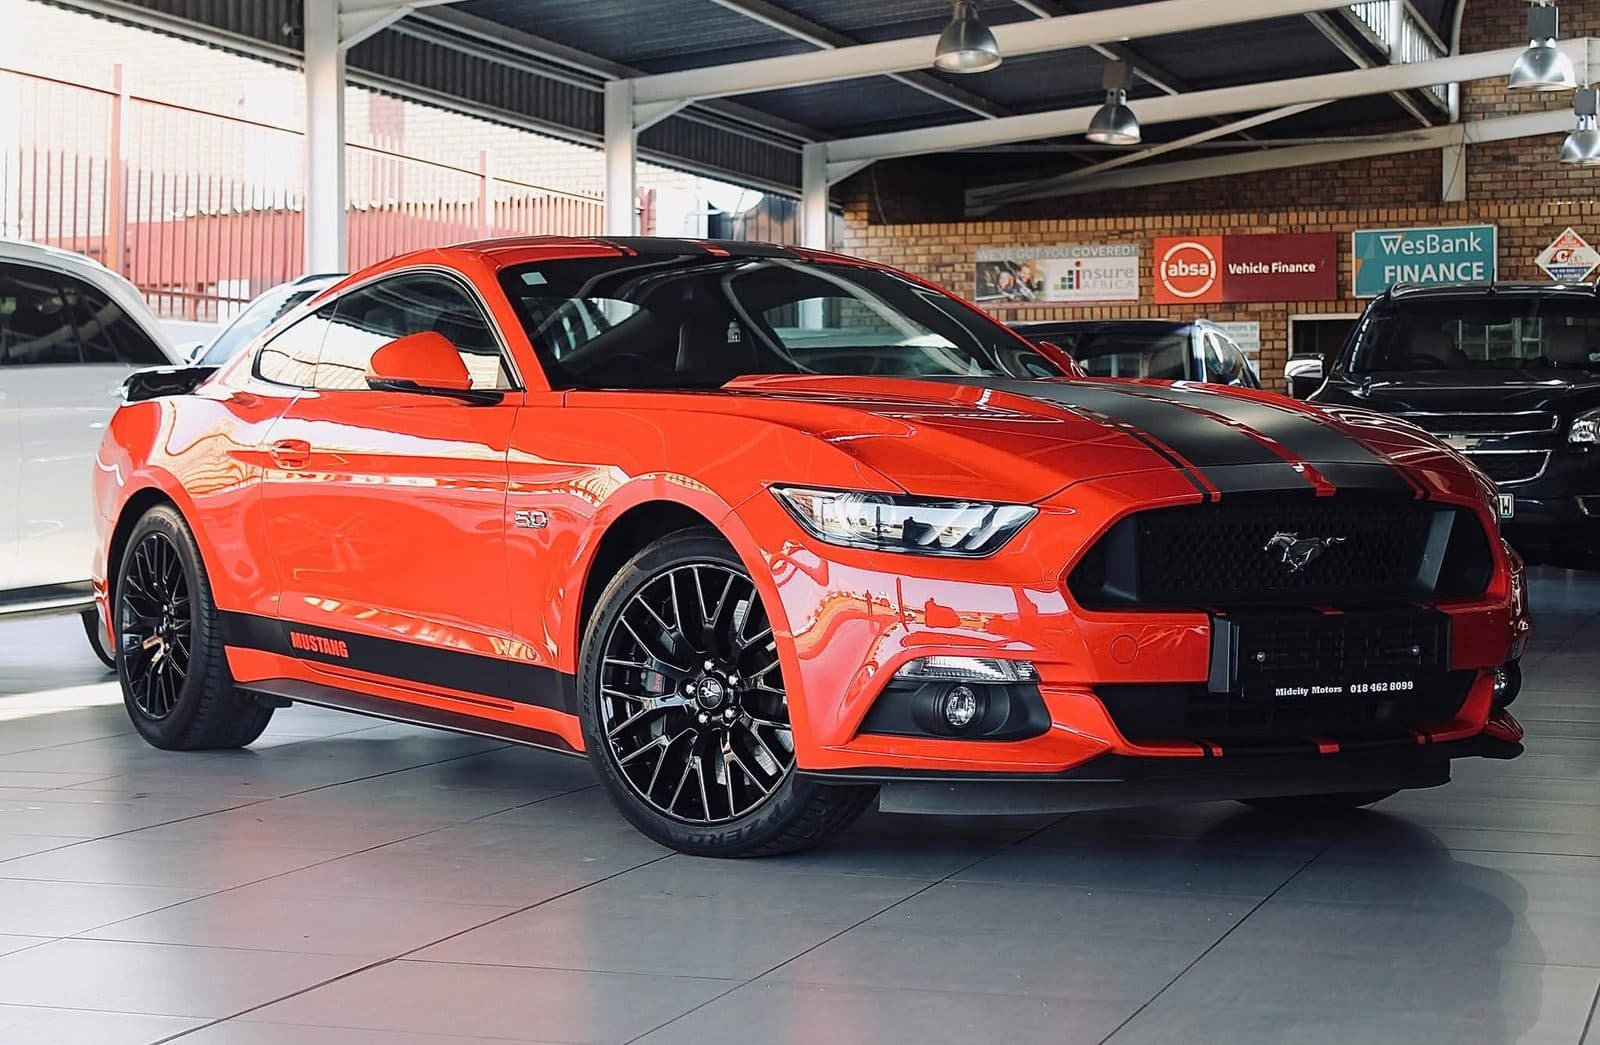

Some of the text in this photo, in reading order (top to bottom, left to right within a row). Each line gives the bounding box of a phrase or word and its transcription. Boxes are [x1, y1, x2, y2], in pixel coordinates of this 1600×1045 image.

[1017, 248, 1039, 259] GOT
[1042, 247, 1069, 258] YOU
[1072, 245, 1136, 257] COVERED!
[1379, 231, 1482, 255] WesBank
[1075, 260, 1135, 290] insure
[1168, 259, 1209, 277] absa
[1228, 261, 1316, 275] Vehicle Finance
[1384, 262, 1484, 284] FINANCE
[1083, 279, 1135, 290] AFRICA
[290, 631, 349, 658] MUSTANG
[1275, 681, 1414, 697] Midcity Motors 018 462 8099
